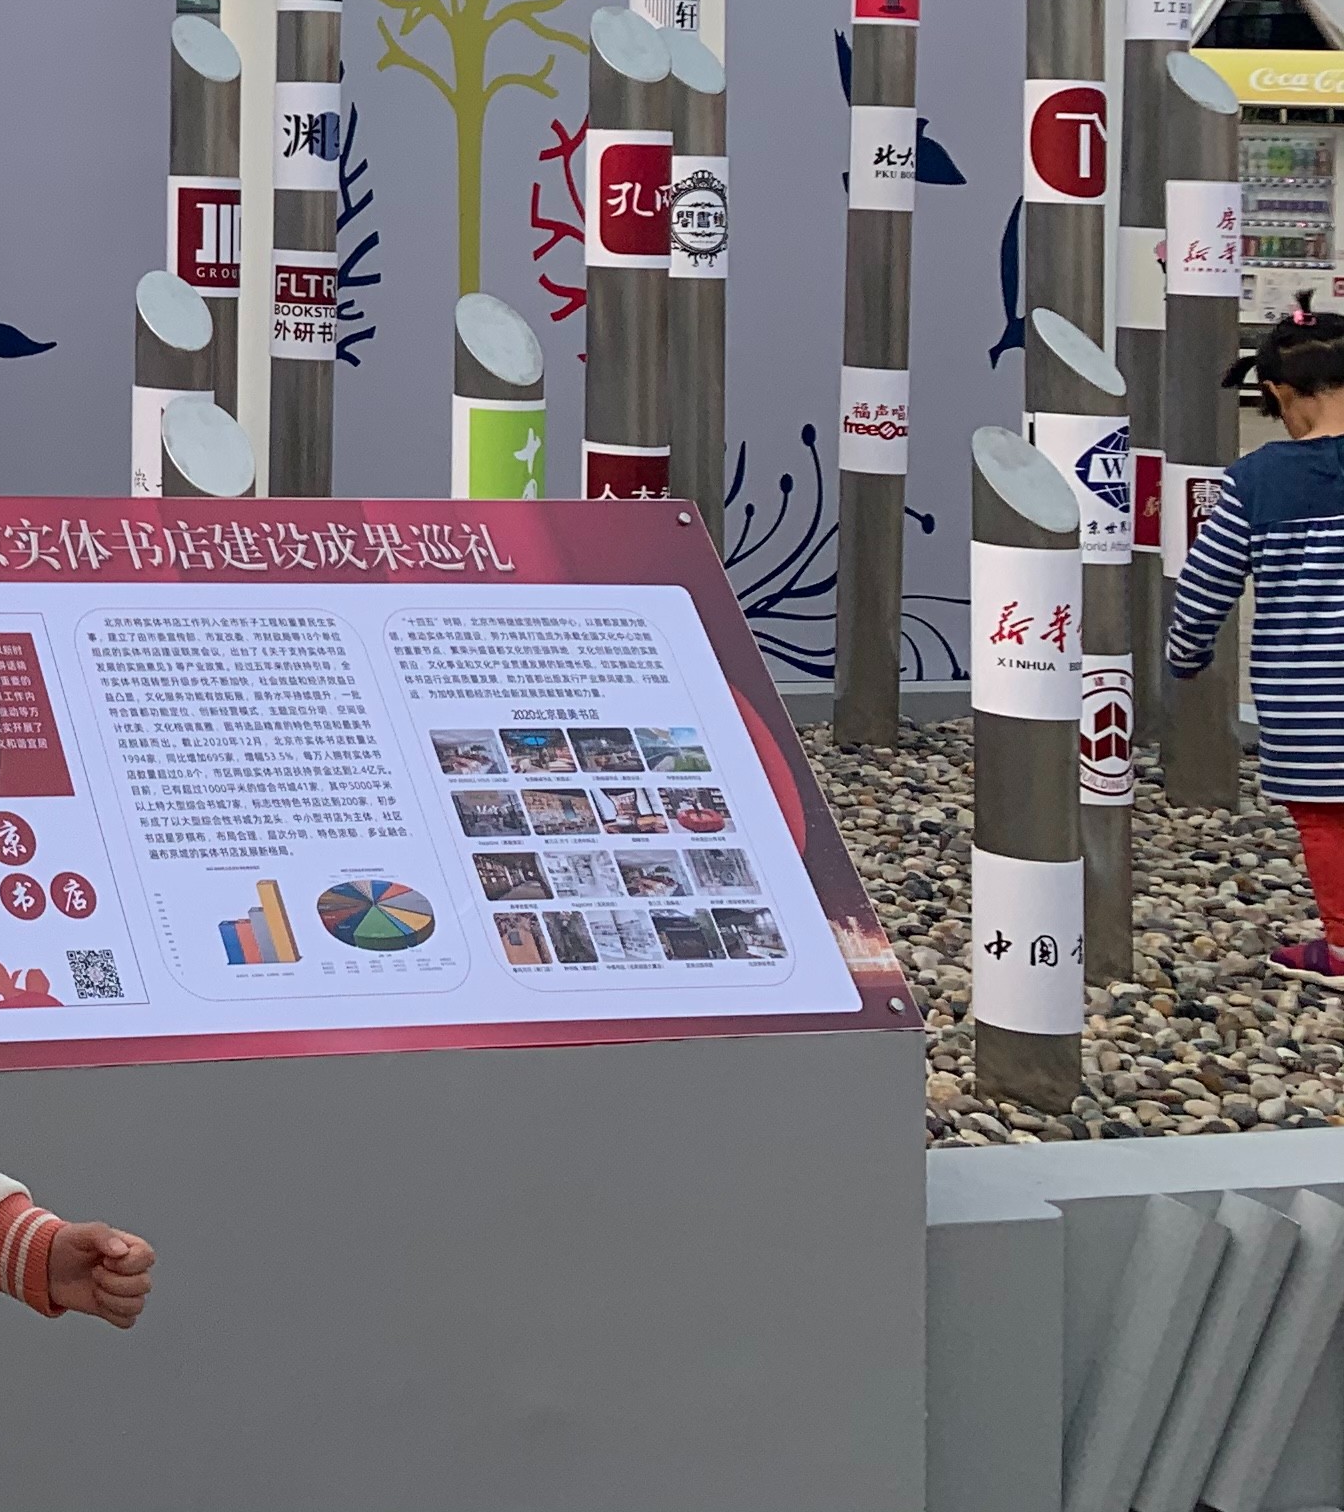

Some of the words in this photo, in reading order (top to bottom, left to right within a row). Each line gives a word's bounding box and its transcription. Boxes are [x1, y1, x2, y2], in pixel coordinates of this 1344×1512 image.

[875, 171, 897, 179] PKU
[195, 266, 241, 280] GROU
[275, 273, 337, 299] FLTR
[274, 304, 337, 320] BOOKSTO
[274, 322, 337, 344] 外研书
[852, 402, 908, 421] 福声唱
[997, 657, 1056, 672] XINHUA
[511, 708, 600, 721] 2020北京最美书店
